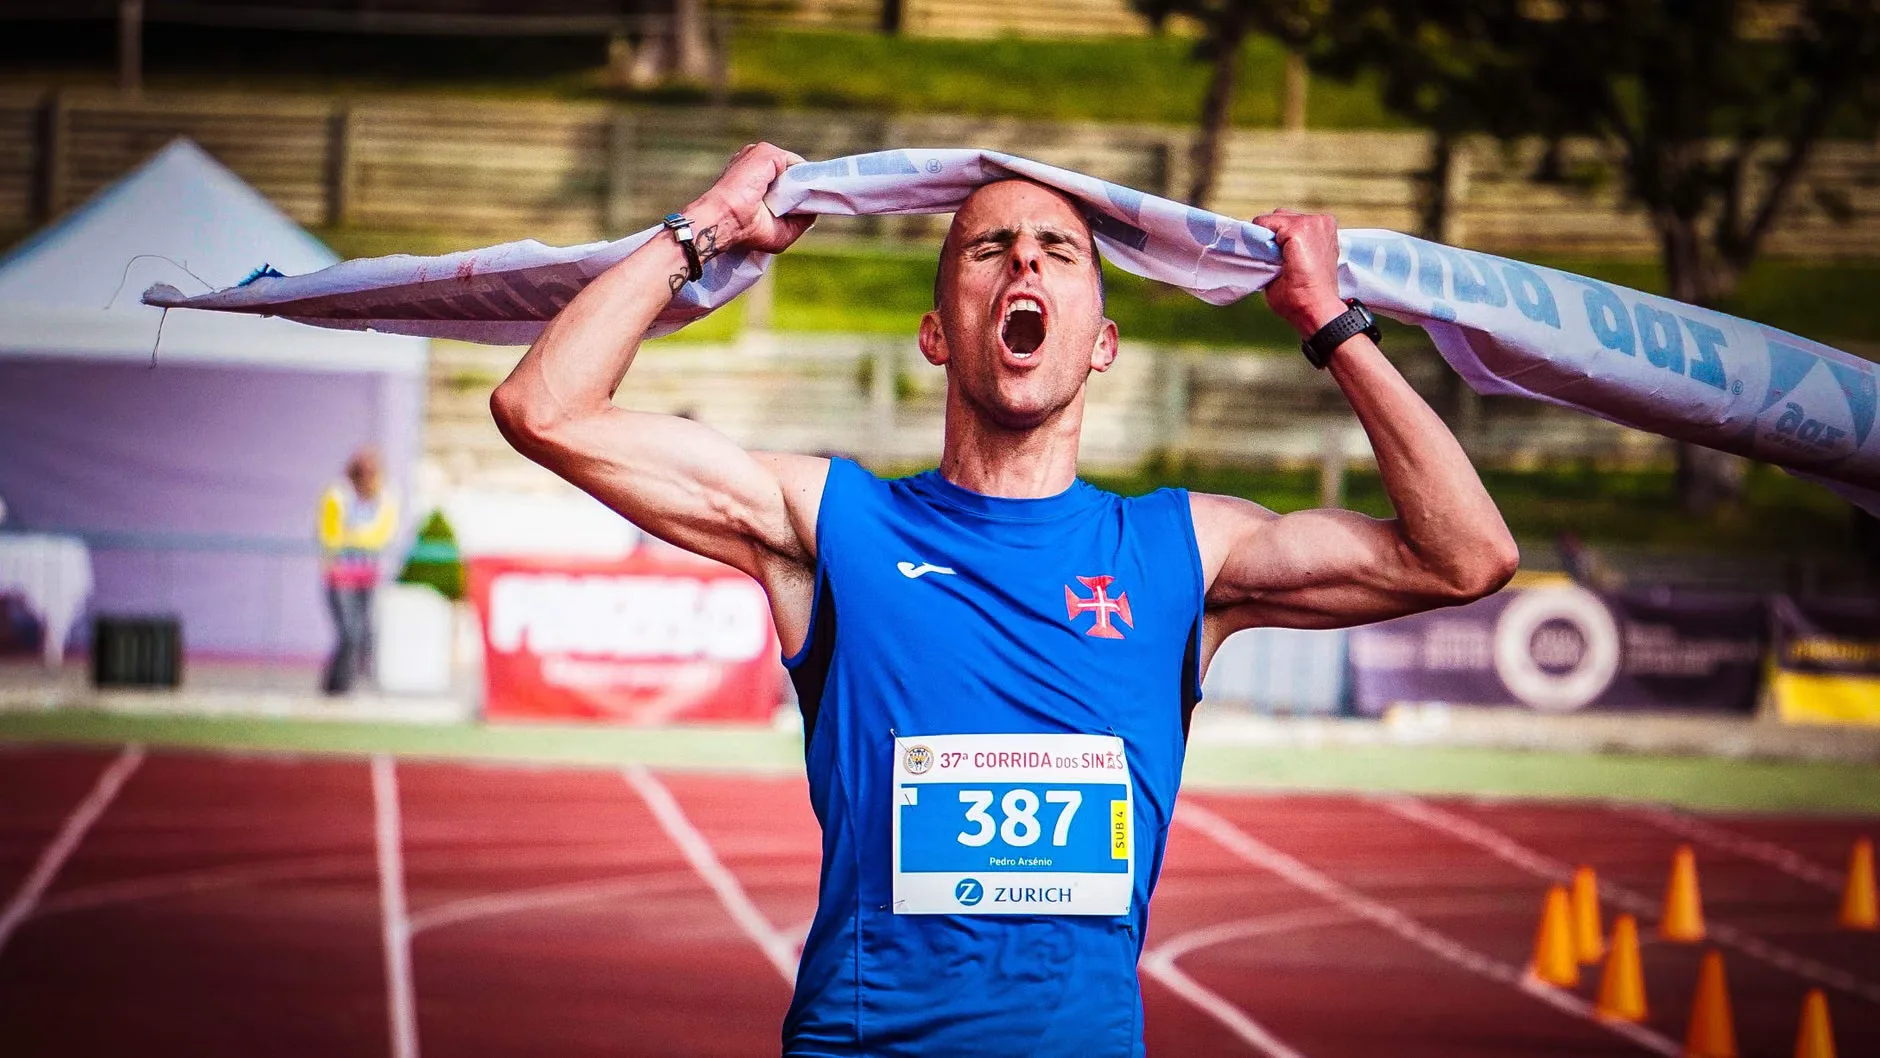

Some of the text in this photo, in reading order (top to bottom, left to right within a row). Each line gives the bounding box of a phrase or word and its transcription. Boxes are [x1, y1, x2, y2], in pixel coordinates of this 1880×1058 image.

[974, 752, 1052, 768] CORRIDA
[1056, 757, 1078, 769] DOS
[957, 789, 1082, 847] 387
[1115, 811, 1125, 849] SUB 4
[989, 856, 1053, 867] Pedro Arsénio
[994, 887, 1072, 903] ZURICH
